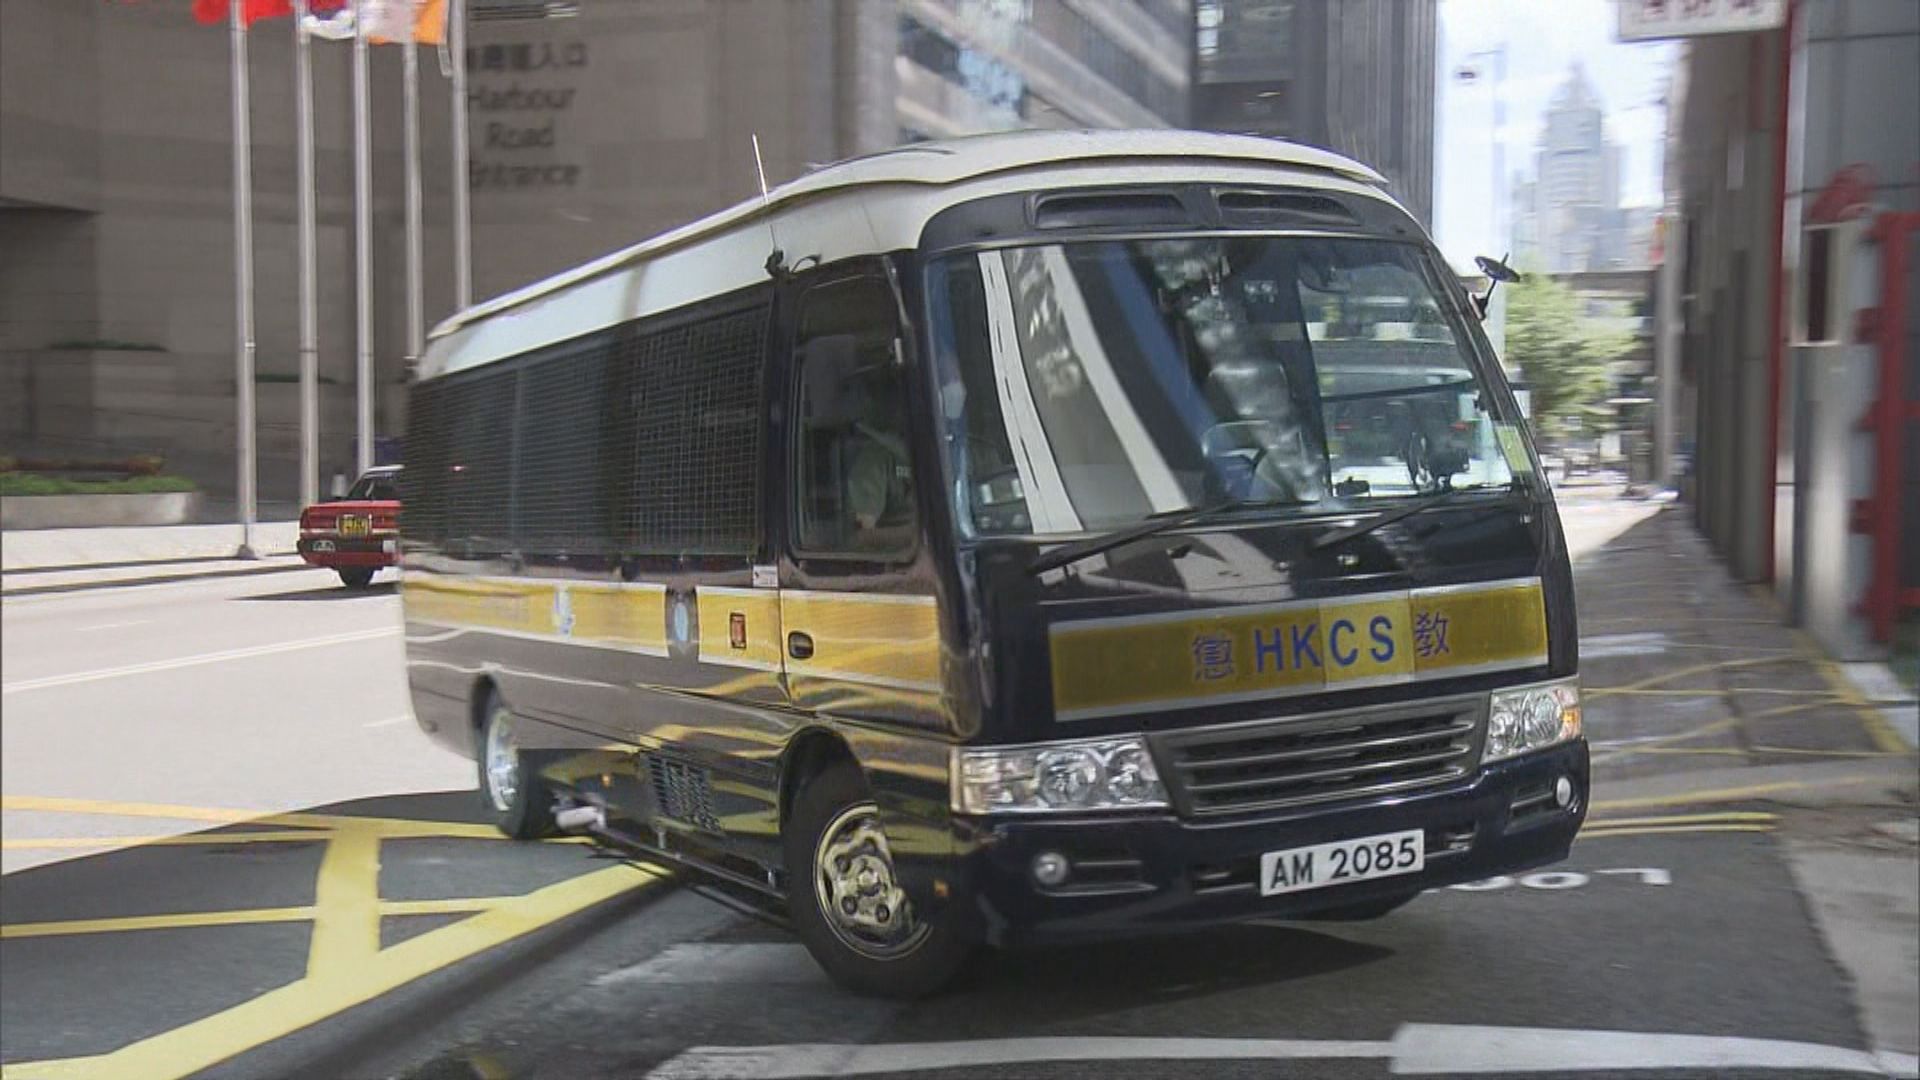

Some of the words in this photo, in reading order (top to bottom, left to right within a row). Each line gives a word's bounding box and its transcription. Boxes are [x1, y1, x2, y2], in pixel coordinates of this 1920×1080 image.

[486, 117, 555, 148] Road
[1253, 615, 1396, 674] HKCS
[1269, 851, 1314, 889] AM
[1329, 837, 1417, 880] 2085
